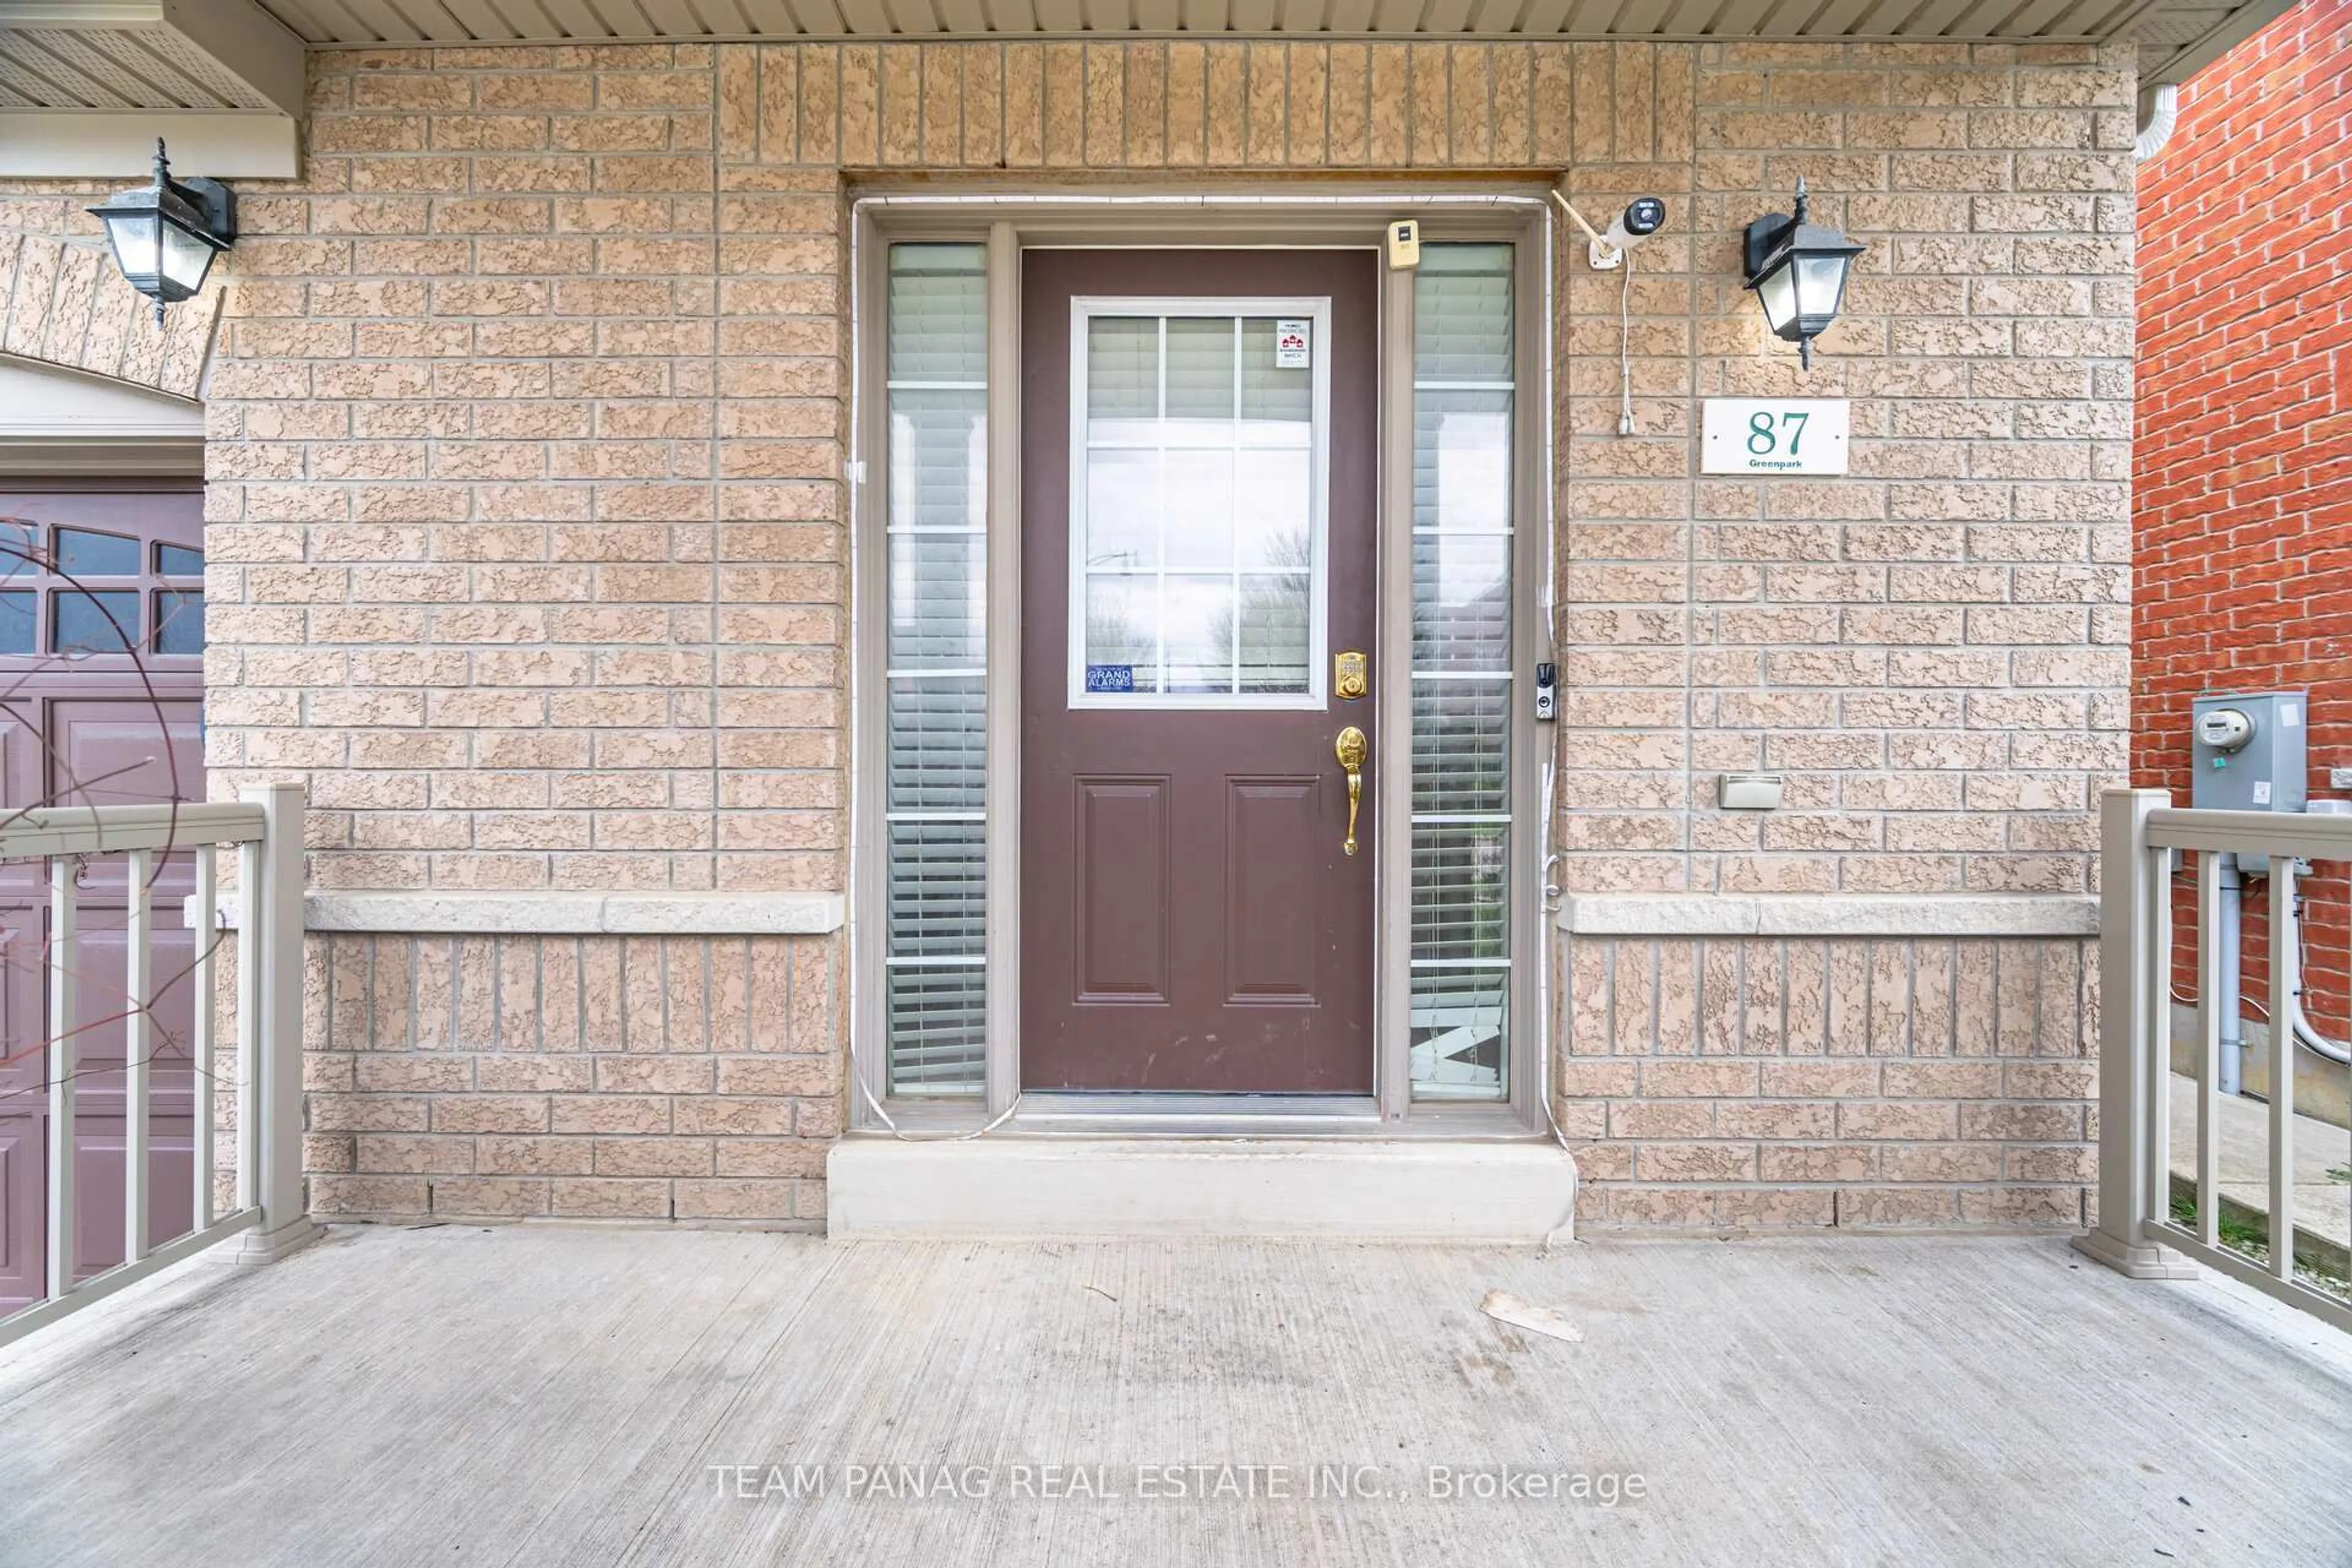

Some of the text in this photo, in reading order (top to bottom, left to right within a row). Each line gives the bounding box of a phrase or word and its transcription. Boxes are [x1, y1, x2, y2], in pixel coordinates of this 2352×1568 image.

[1747, 411, 1809, 455] 87
[1749, 459, 1802, 470] Greenpark
[1087, 670, 1131, 679] GRAND
[1087, 678, 1131, 687] ALARMS
